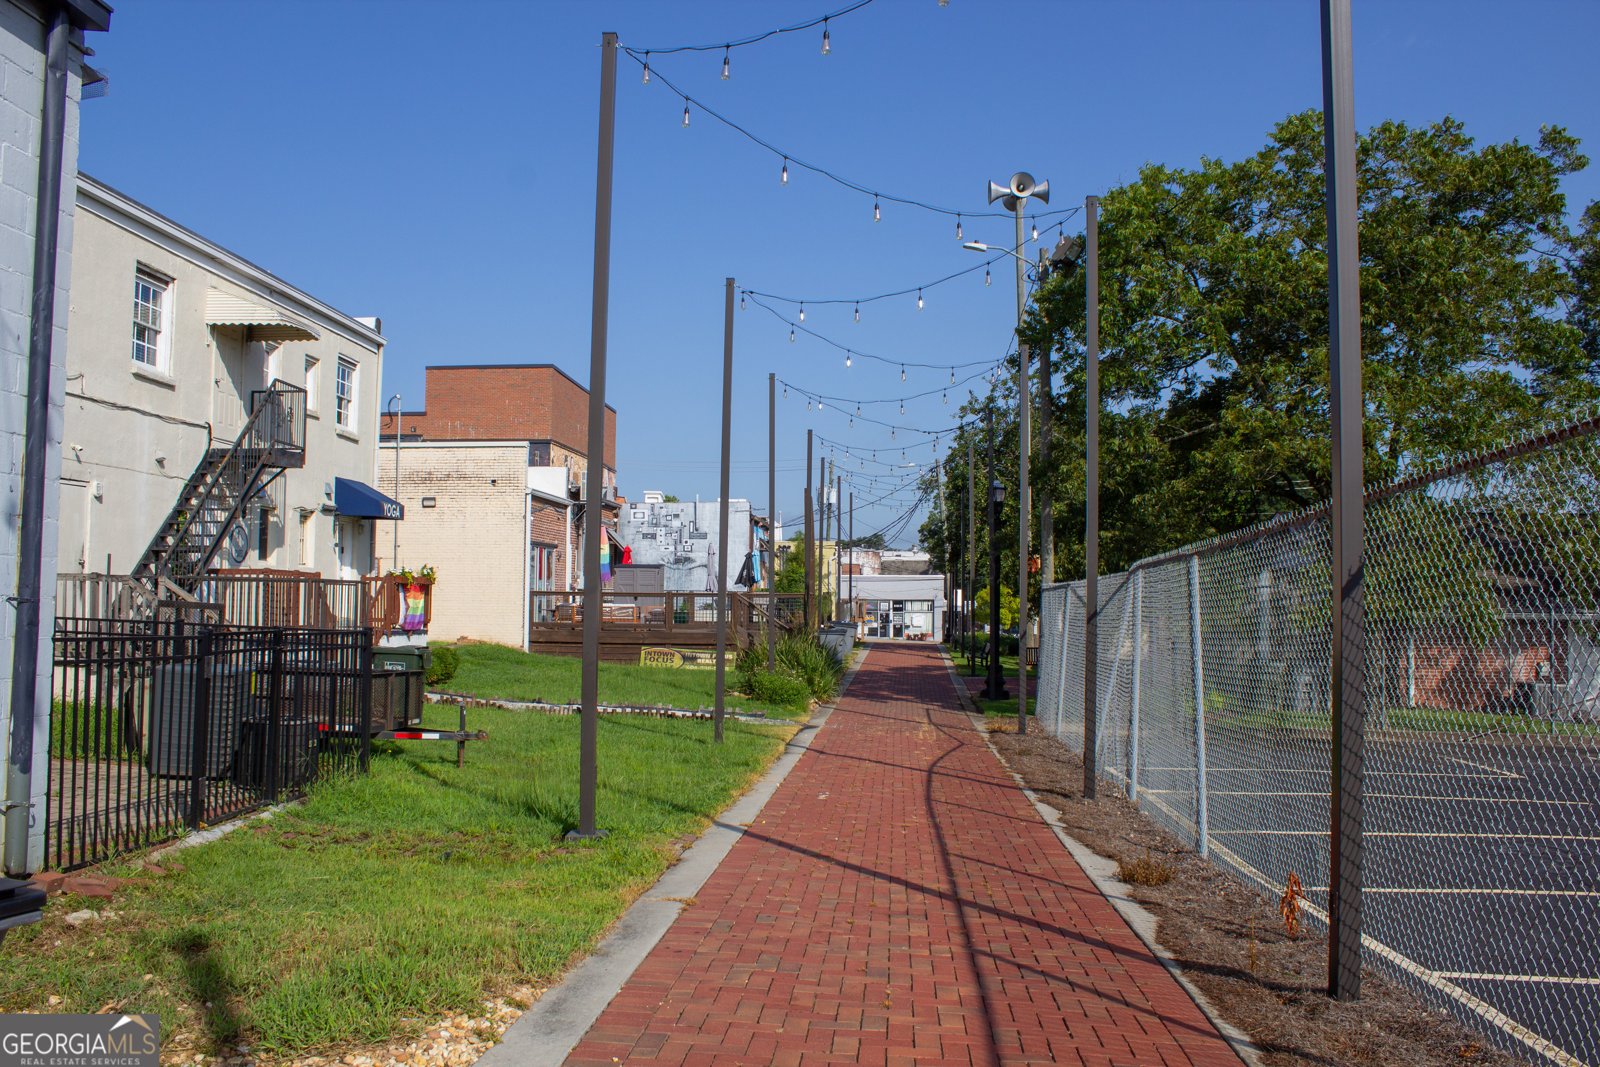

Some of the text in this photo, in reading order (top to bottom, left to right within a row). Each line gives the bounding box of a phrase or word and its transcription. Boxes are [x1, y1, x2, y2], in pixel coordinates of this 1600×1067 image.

[383, 503, 400, 518] YOGA
[644, 650, 675, 658] INTOWN
[644, 656, 674, 664] FOCUS
